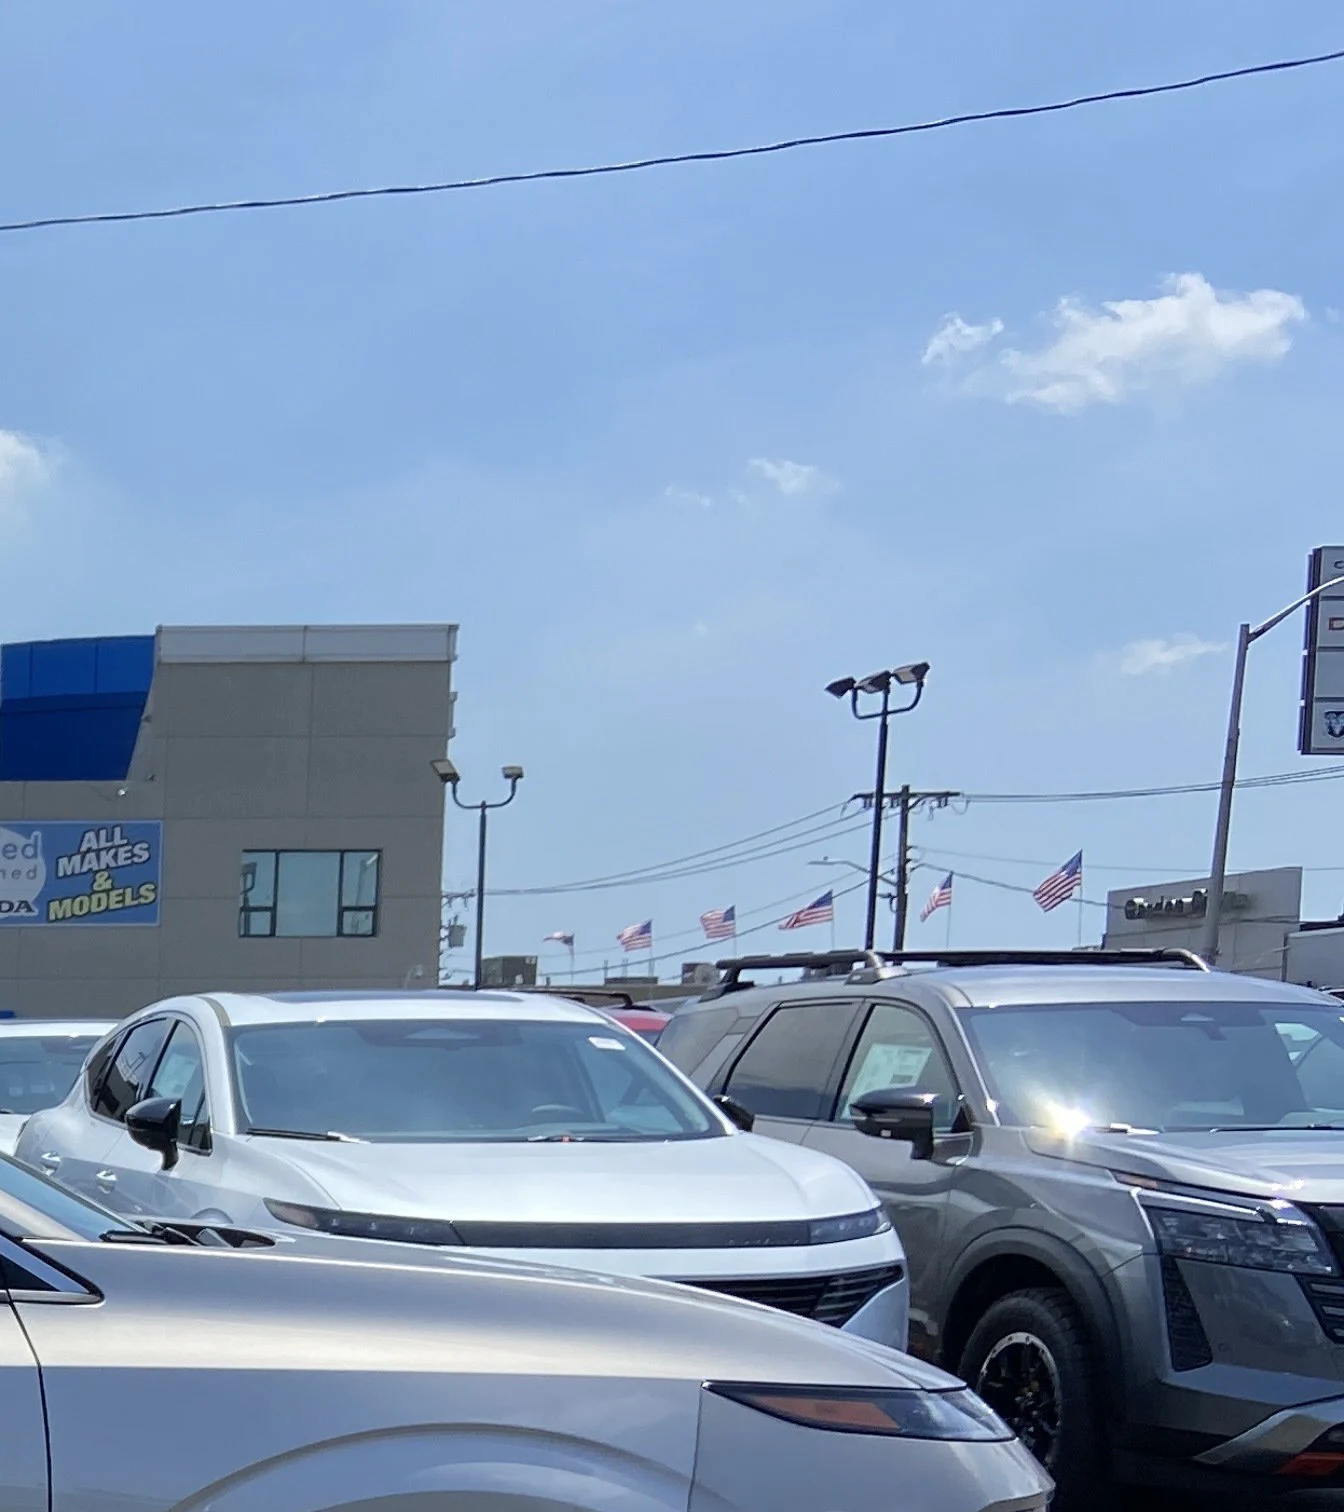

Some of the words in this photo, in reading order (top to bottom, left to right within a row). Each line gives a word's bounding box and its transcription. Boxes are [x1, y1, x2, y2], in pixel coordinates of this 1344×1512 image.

[79, 825, 128, 852] ALL
[57, 843, 151, 878] MAKES
[92, 871, 113, 891] &
[48, 883, 157, 922] MODELS
